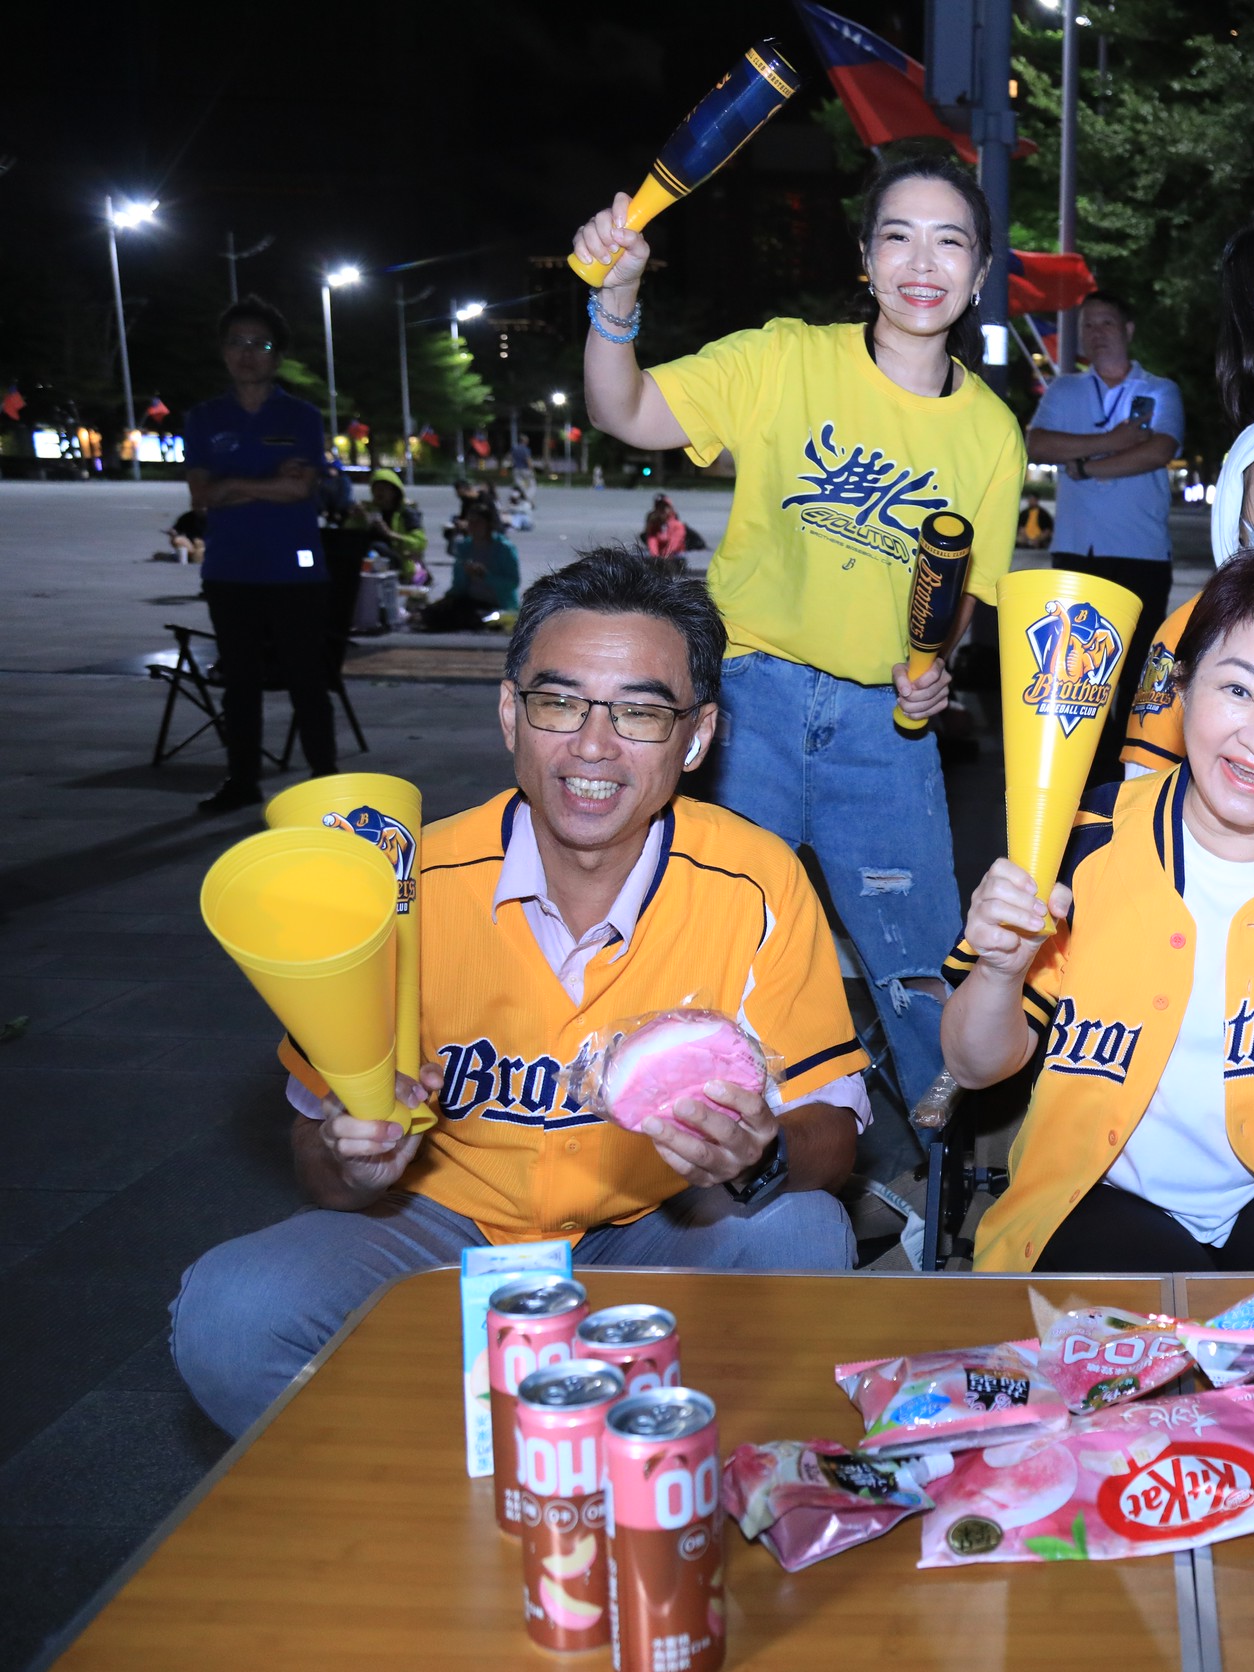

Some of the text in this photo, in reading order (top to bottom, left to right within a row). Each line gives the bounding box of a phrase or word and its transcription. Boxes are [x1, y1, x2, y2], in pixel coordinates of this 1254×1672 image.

[911, 554, 943, 639] Brothers
[1023, 673, 1110, 704] Brothers
[1079, 706, 1097, 717] CLUB
[1126, 1457, 1238, 1525] KitKat
